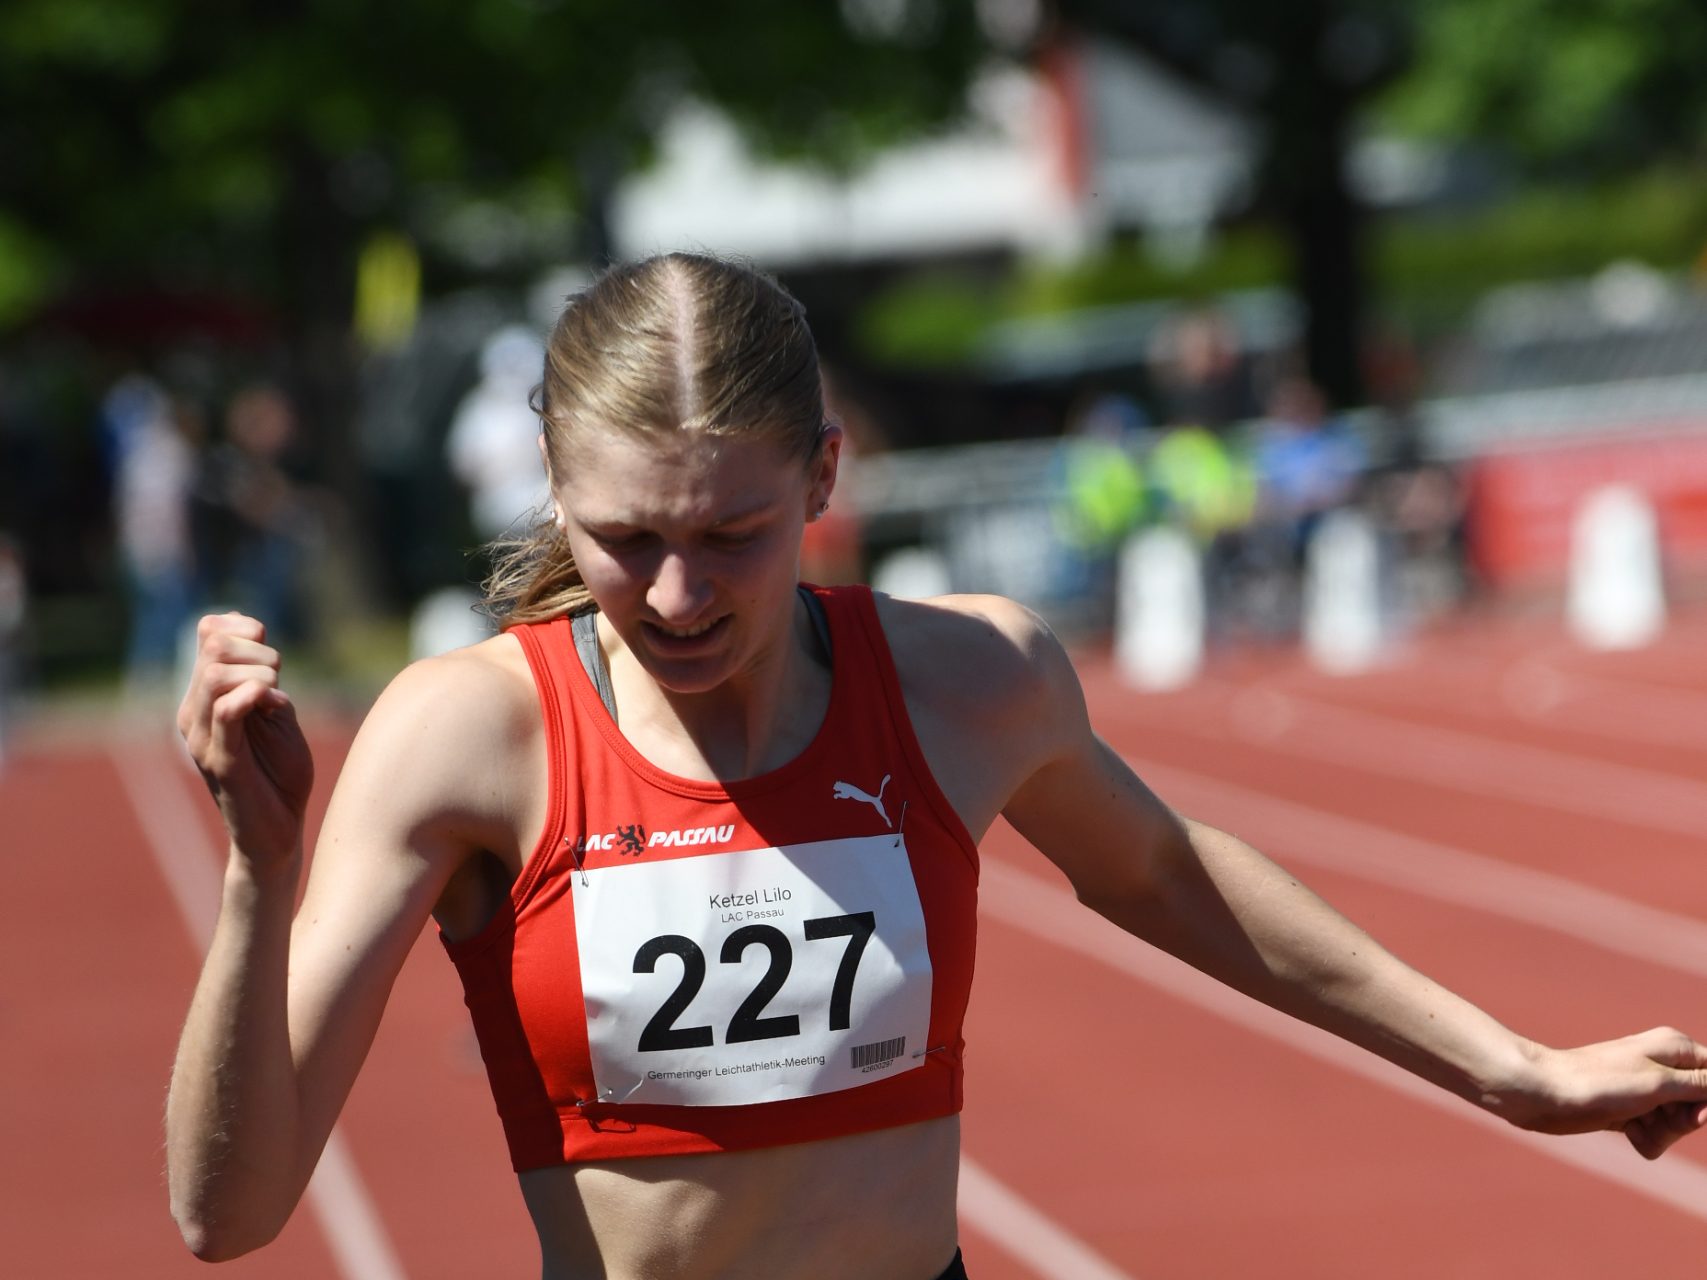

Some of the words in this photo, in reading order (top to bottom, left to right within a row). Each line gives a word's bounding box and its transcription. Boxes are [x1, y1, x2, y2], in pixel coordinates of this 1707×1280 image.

[577, 834, 616, 852] LAC
[648, 825, 735, 847] PASSAU
[709, 890, 758, 909] Ketzel
[763, 887, 792, 903] Lilo
[721, 912, 744, 923] LAC
[746, 908, 785, 920] Passau
[632, 911, 876, 1053] 227
[647, 1069, 712, 1080] Germeringer
[715, 1055, 826, 1076] Leichtathletik-Meeting
